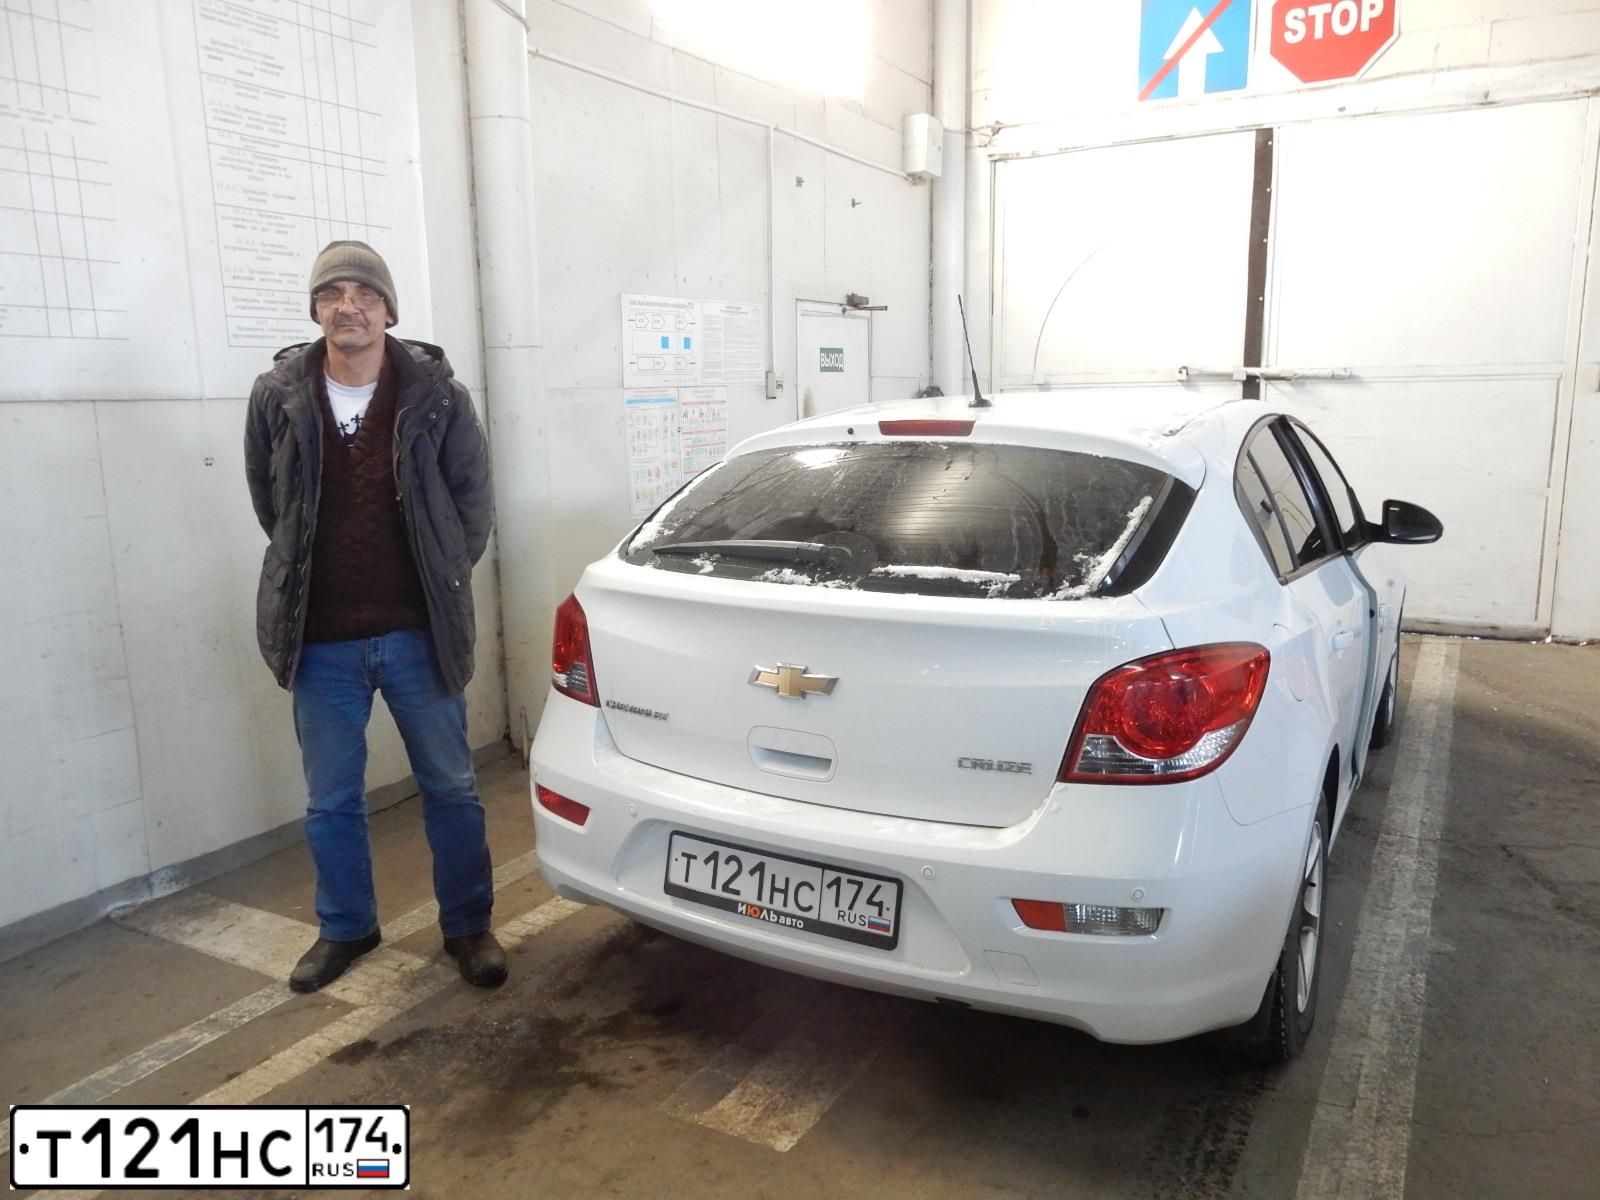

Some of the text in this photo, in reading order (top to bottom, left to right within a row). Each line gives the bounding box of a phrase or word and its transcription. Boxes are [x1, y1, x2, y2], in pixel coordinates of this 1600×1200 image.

[1283, 0, 1384, 44] STOP
[820, 352, 844, 371] ВЫХОД
[957, 756, 1033, 775] CRUZE
[826, 876, 885, 917] 174
[837, 910, 867, 927] RUS
